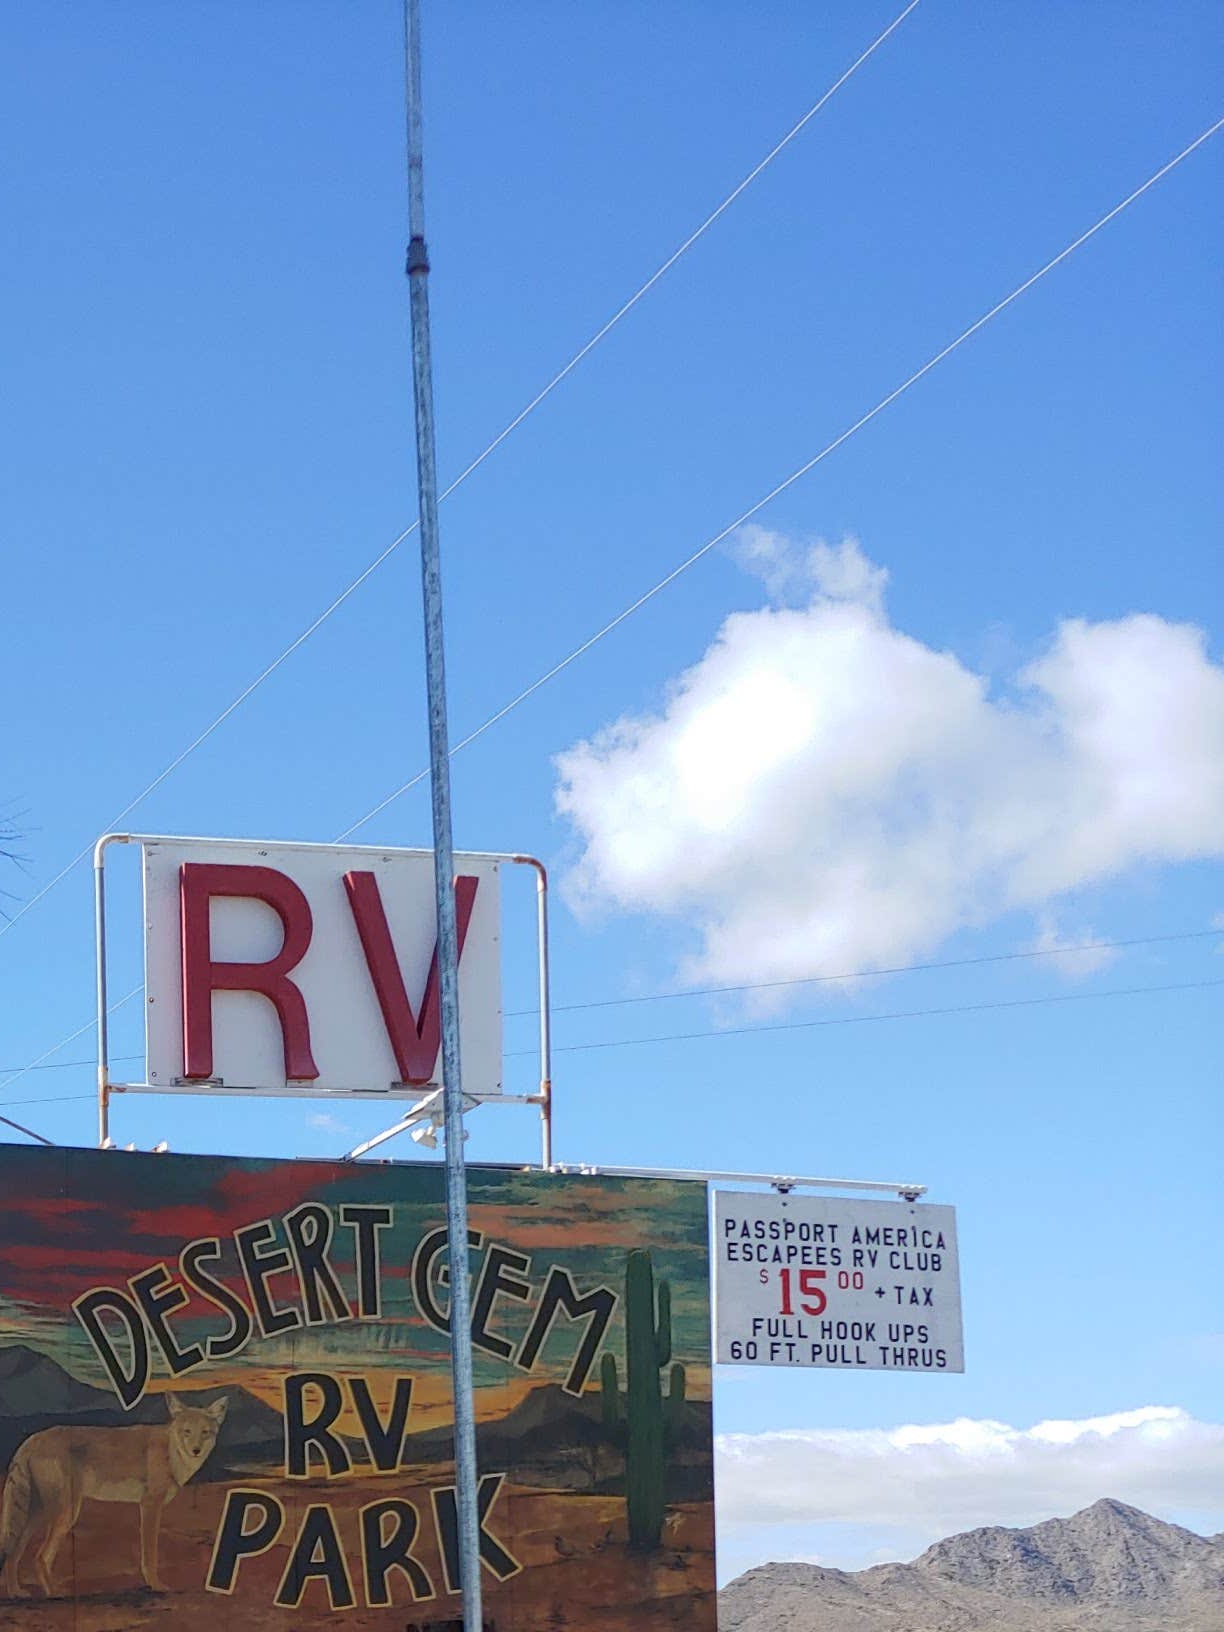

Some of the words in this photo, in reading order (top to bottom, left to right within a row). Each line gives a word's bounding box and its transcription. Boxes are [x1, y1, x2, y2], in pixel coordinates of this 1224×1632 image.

[178, 862, 479, 1086] RV
[724, 1218, 839, 1244] PASSPORT
[851, 1225, 946, 1250] AMERICA
[727, 1242, 842, 1266] ESCAPEES
[852, 1249, 878, 1269] RV
[889, 1251, 943, 1272] CLUB
[71, 1201, 394, 1411] DESERT
[410, 1227, 620, 1398] GEM
[894, 1286, 934, 1307] TAX
[752, 1318, 808, 1339] FULL
[821, 1321, 877, 1343] HOOK
[888, 1324, 929, 1344] UPS
[730, 1341, 758, 1361] 60
[770, 1343, 800, 1363] FT.
[811, 1345, 866, 1365] PULL
[879, 1346, 948, 1368] THRUS
[282, 1372, 412, 1480] RV
[204, 1472, 523, 1611] PARK
